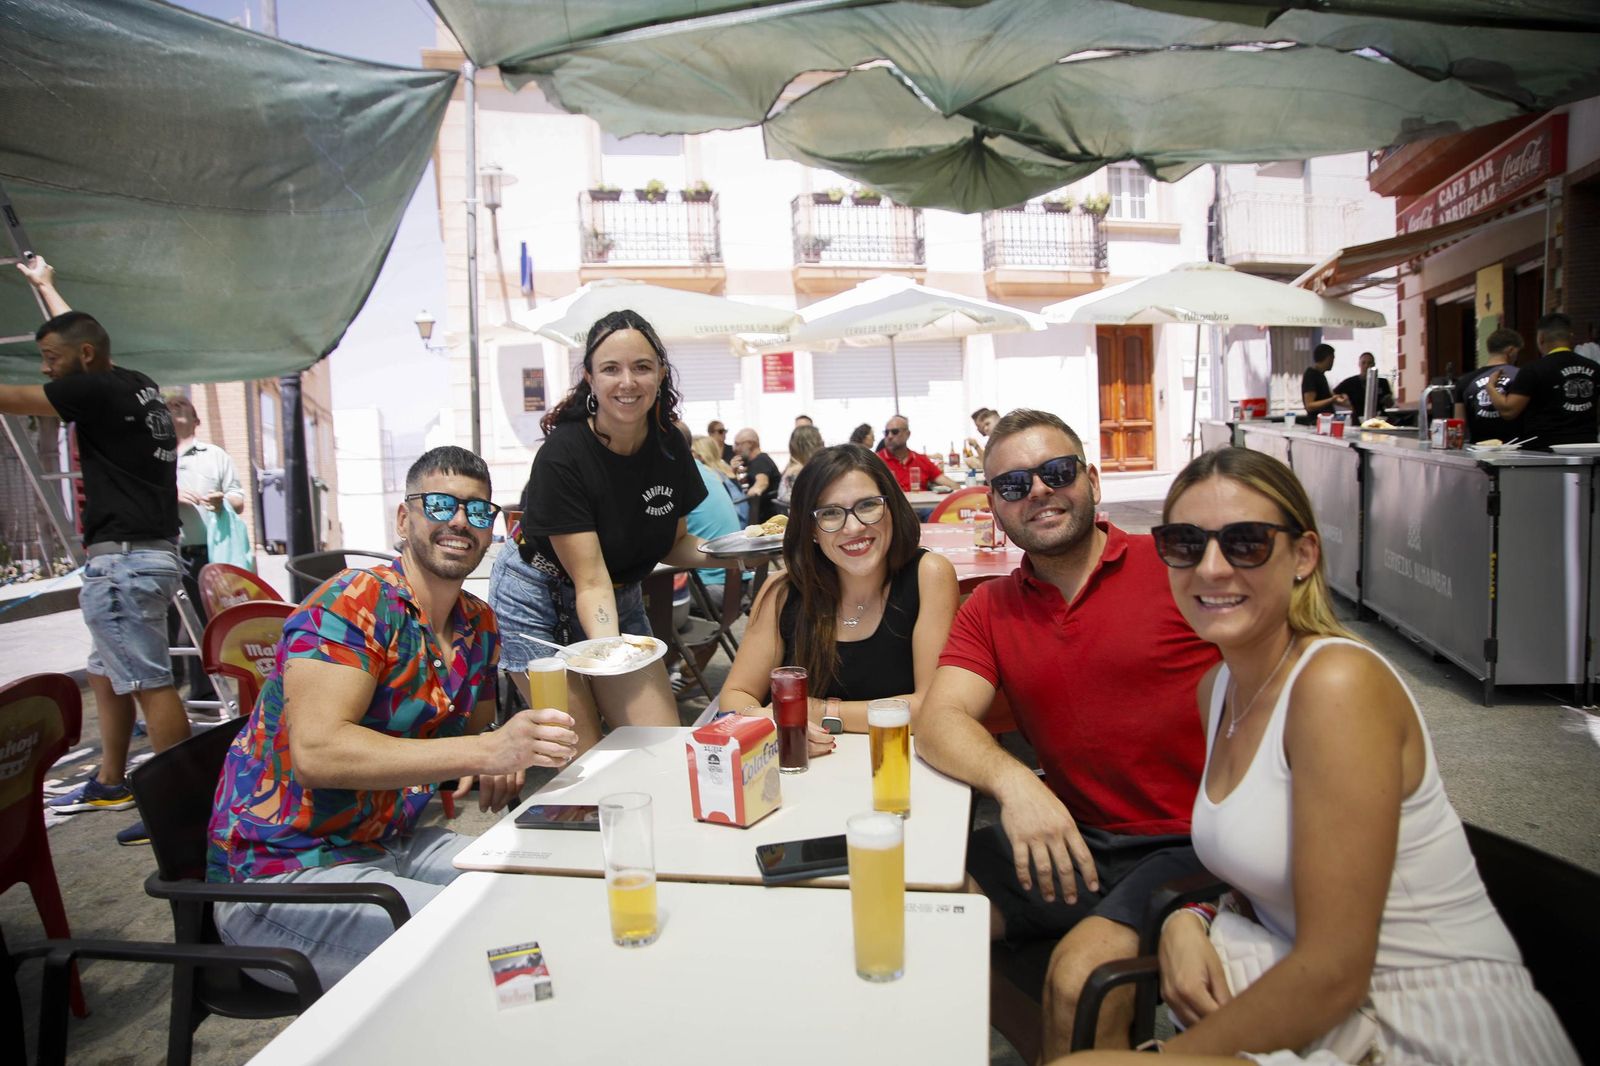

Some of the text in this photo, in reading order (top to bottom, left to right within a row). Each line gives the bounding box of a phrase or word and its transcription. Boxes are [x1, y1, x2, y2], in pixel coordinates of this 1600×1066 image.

[1438, 159, 1494, 206] CAFE BAR
[1439, 183, 1496, 225] ARRUPLAZ
[642, 485, 673, 502] ARRUPLAZ
